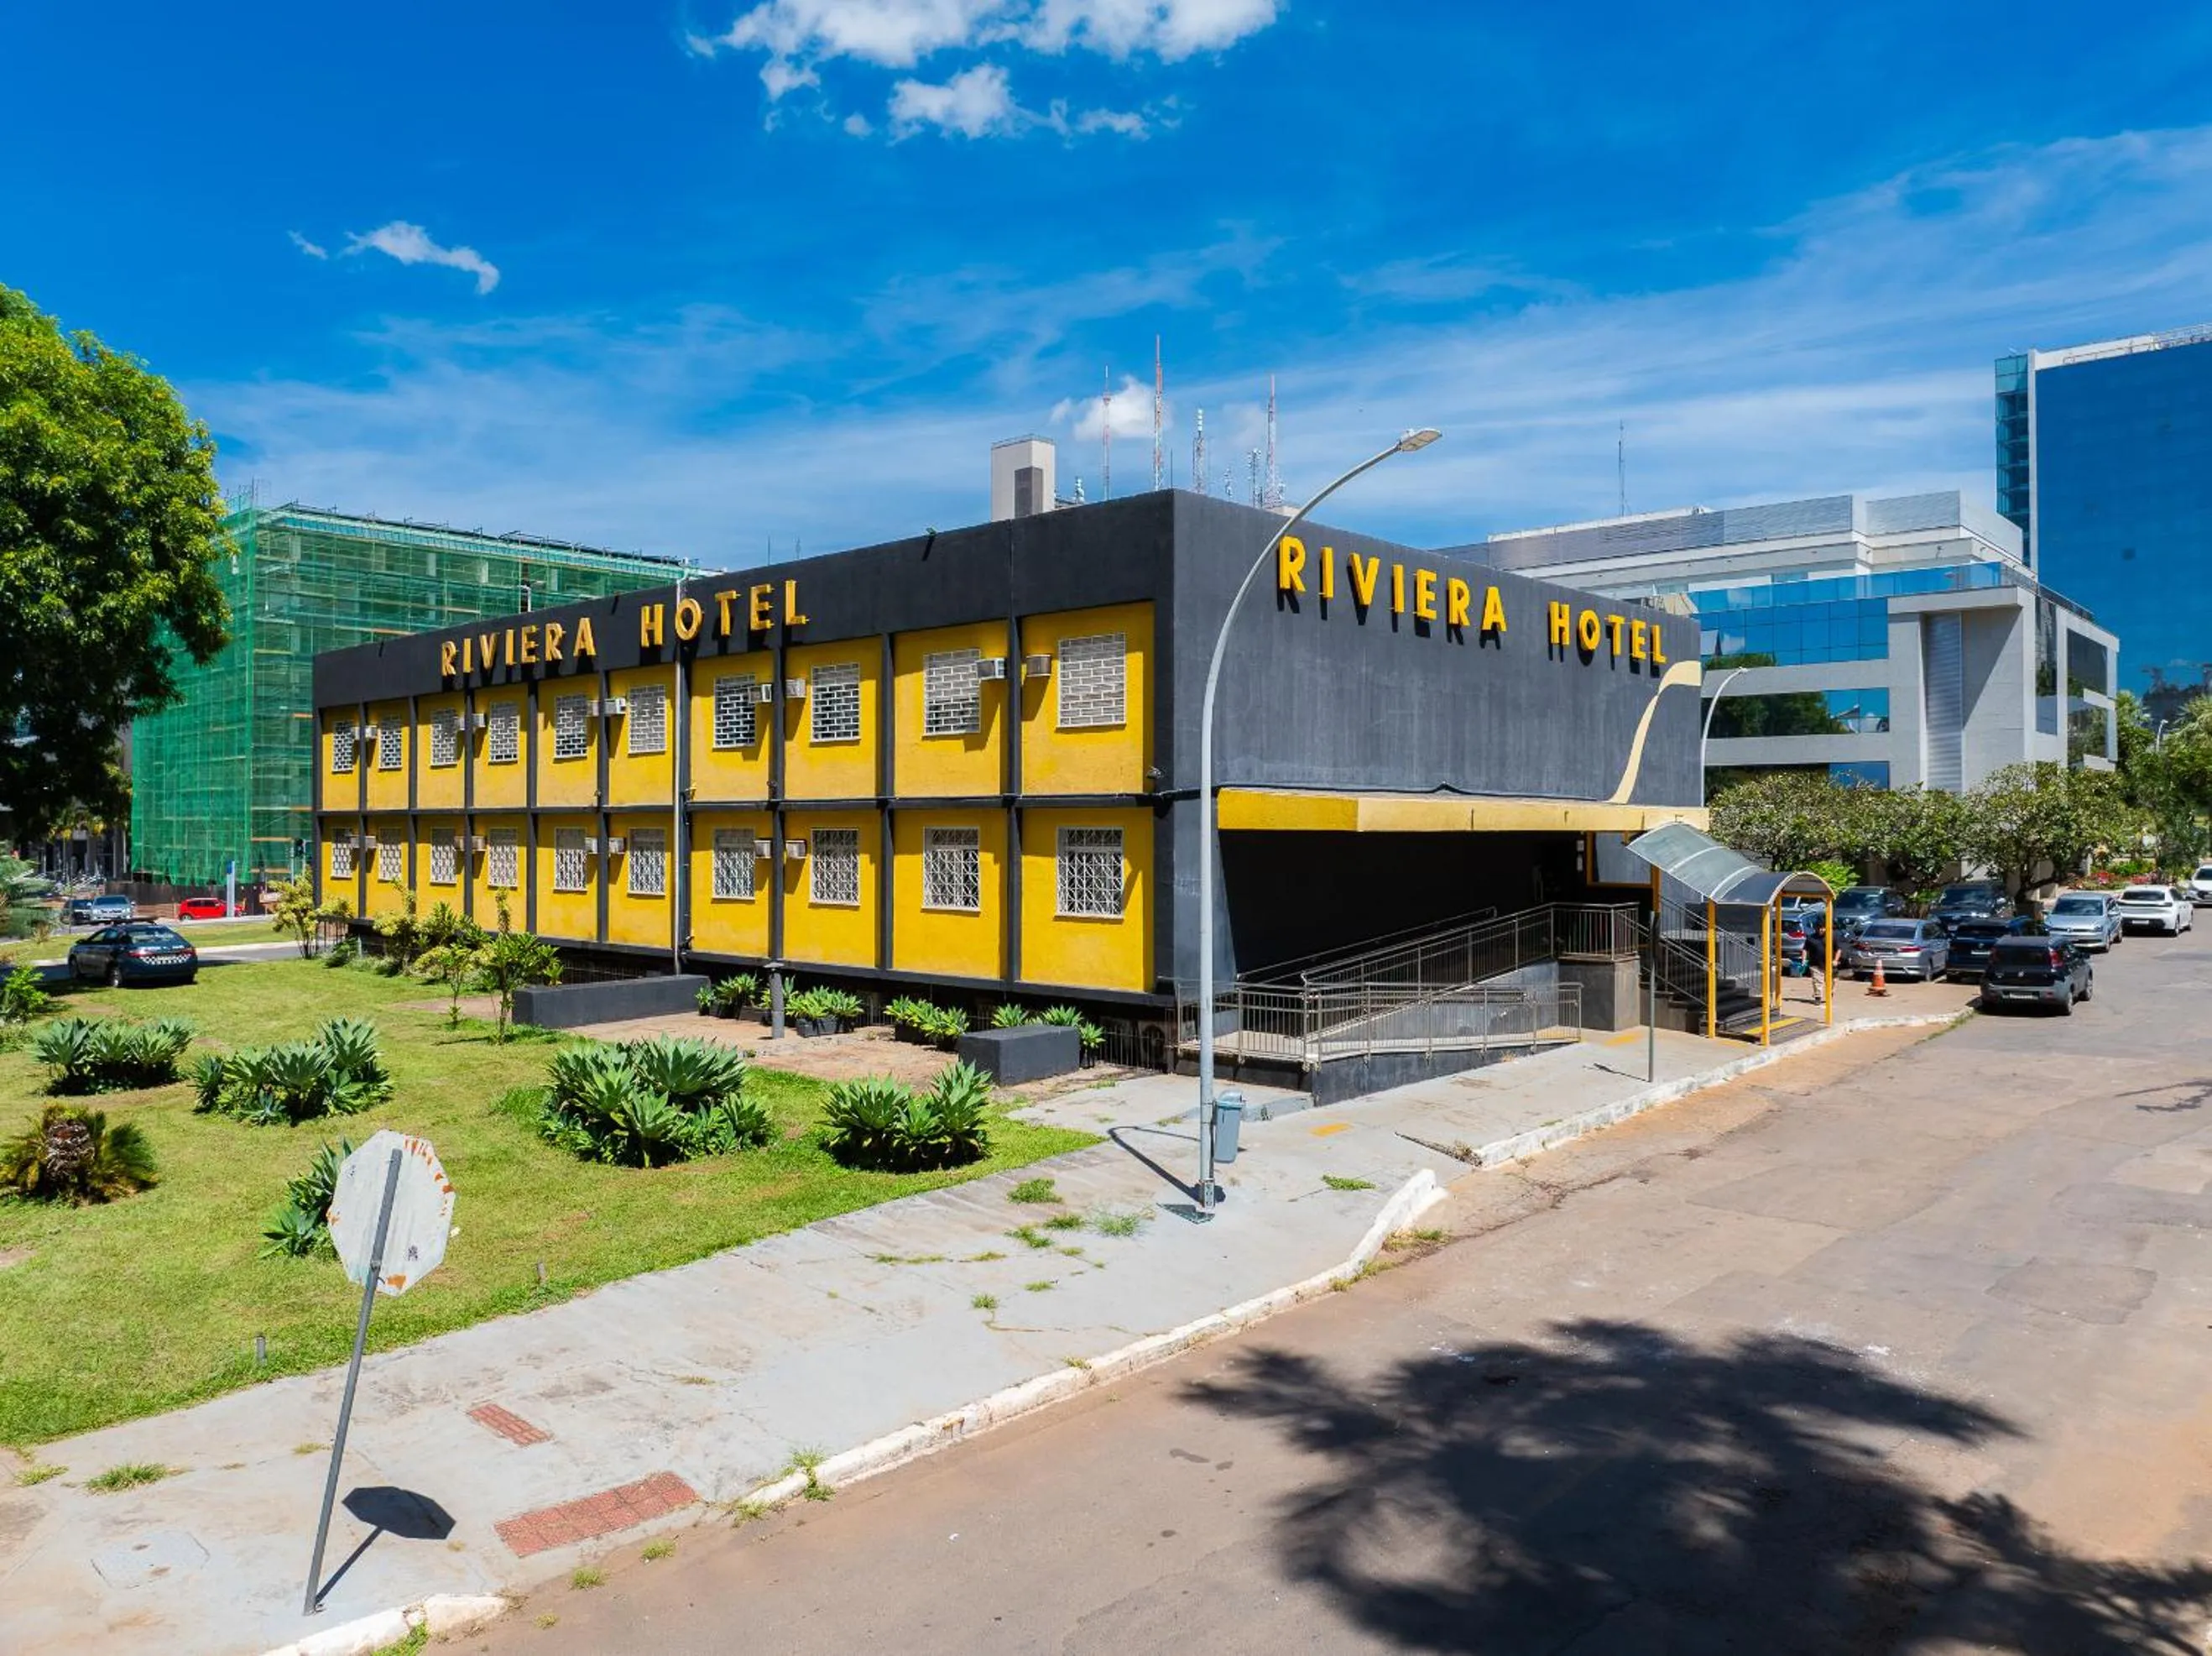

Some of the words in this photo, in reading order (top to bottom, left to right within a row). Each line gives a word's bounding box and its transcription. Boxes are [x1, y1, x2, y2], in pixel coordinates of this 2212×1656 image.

[441, 618, 597, 677] RIVIERA
[640, 579, 811, 648] HOTEL
[1278, 535, 1507, 632] RIVIERA
[1548, 600, 1667, 664] HOTEL
